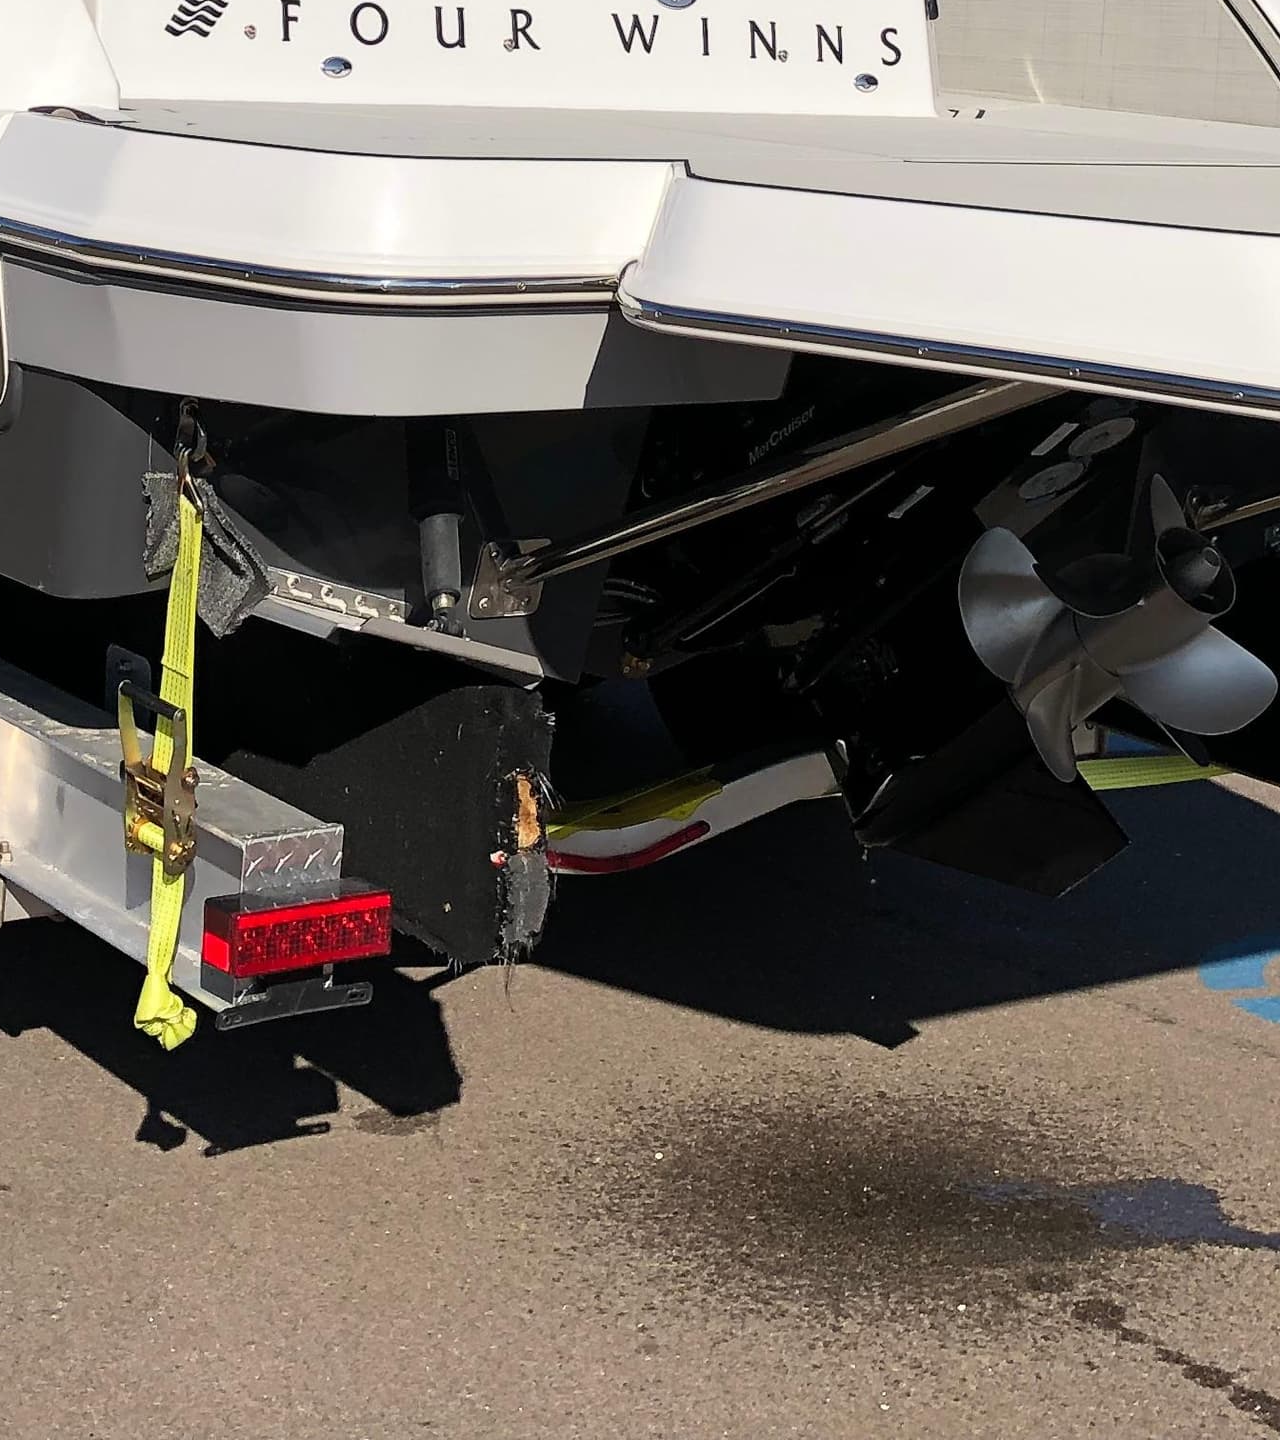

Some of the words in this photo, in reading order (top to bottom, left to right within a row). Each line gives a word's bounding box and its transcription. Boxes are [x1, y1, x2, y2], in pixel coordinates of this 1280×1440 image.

[280, 0, 541, 51] FOUR
[608, 13, 903, 67] WINNS
[747, 404, 816, 466] MerCruiser
